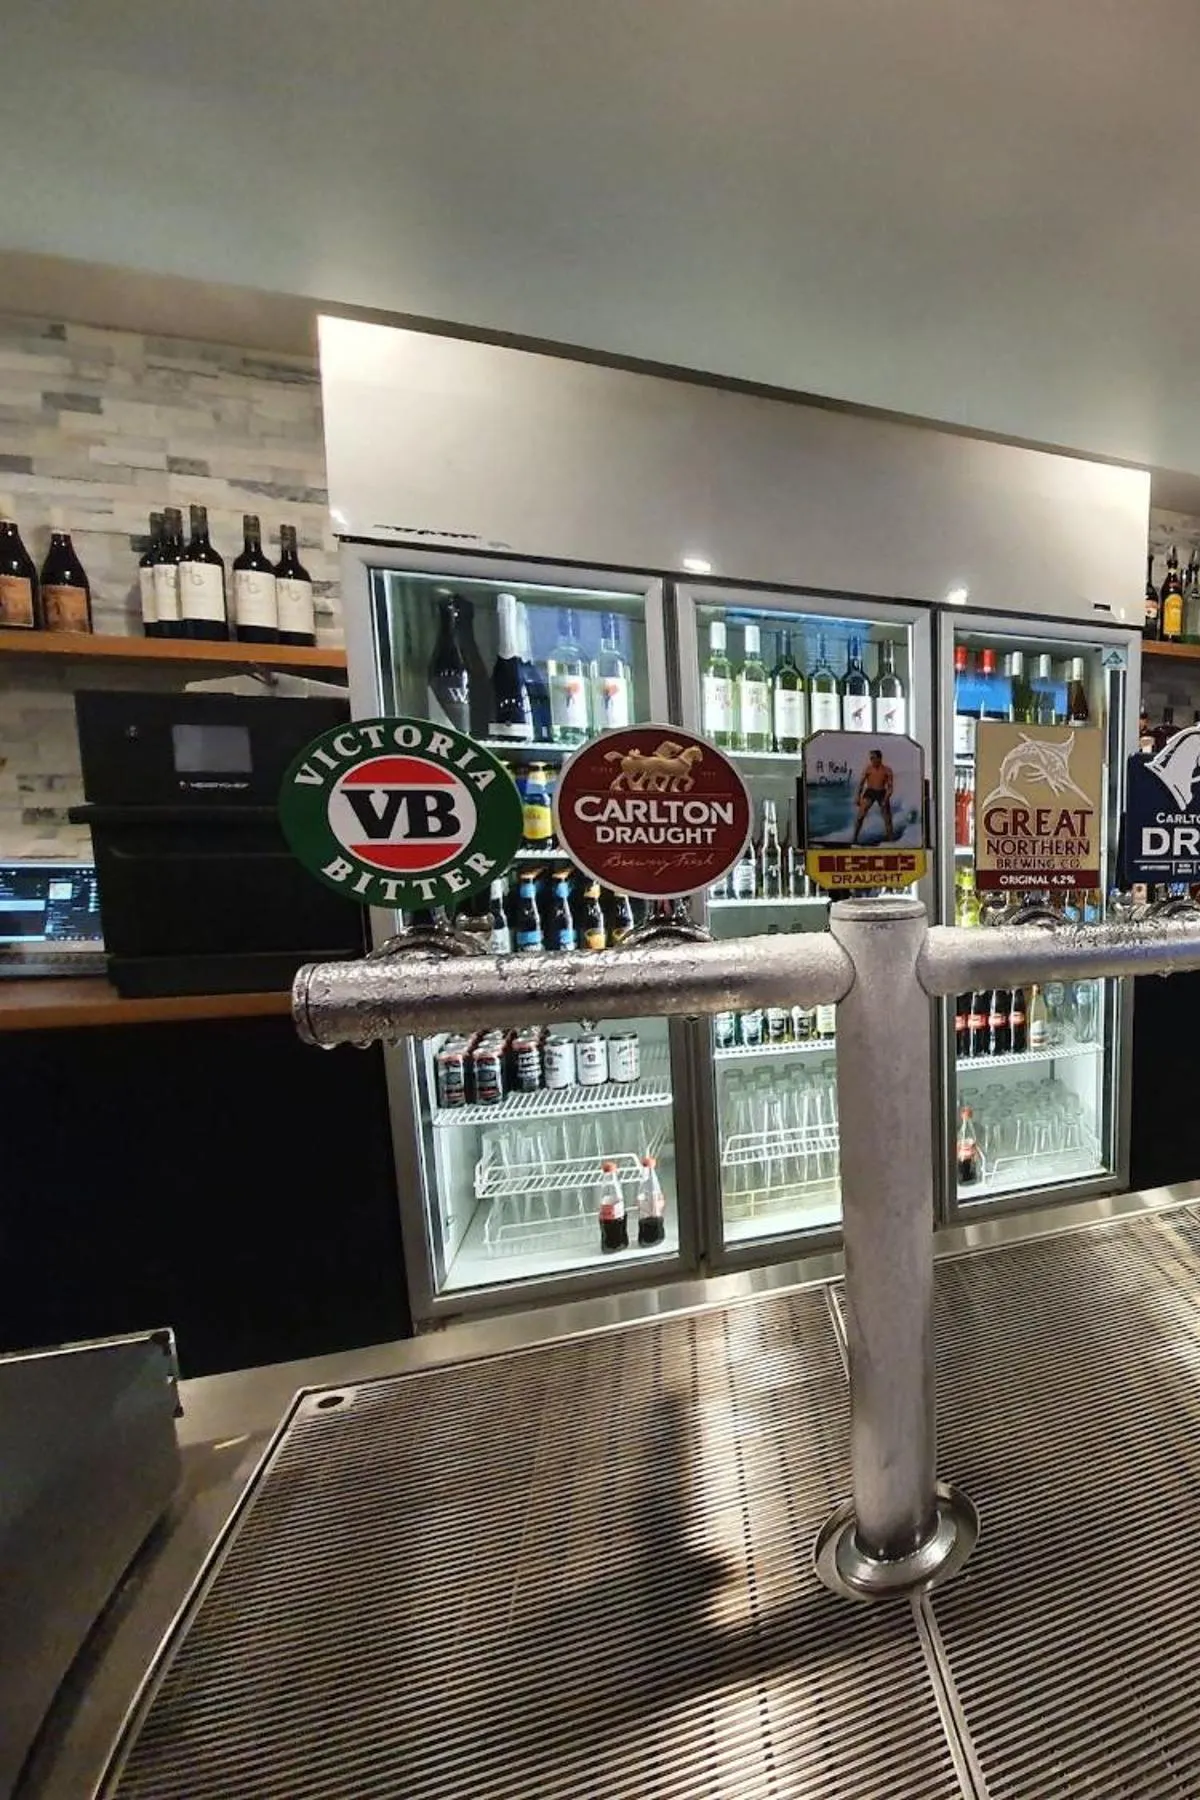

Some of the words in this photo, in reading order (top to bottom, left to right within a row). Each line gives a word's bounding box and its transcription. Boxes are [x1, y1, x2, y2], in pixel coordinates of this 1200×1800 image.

[294, 724, 497, 792] VICTORIA
[340, 788, 462, 840] VB
[573, 795, 734, 825] CARLTON
[983, 807, 1094, 837] GREAT
[595, 826, 717, 845] DRAUGHT
[986, 839, 1090, 856] NORTHERN
[996, 858, 1056, 869] BREWING
[320, 851, 497, 901] BITTER
[831, 873, 904, 885] DRAUGHT
[999, 875, 1049, 885] ORIGINAL
[1050, 875, 1076, 885] 4.2%
